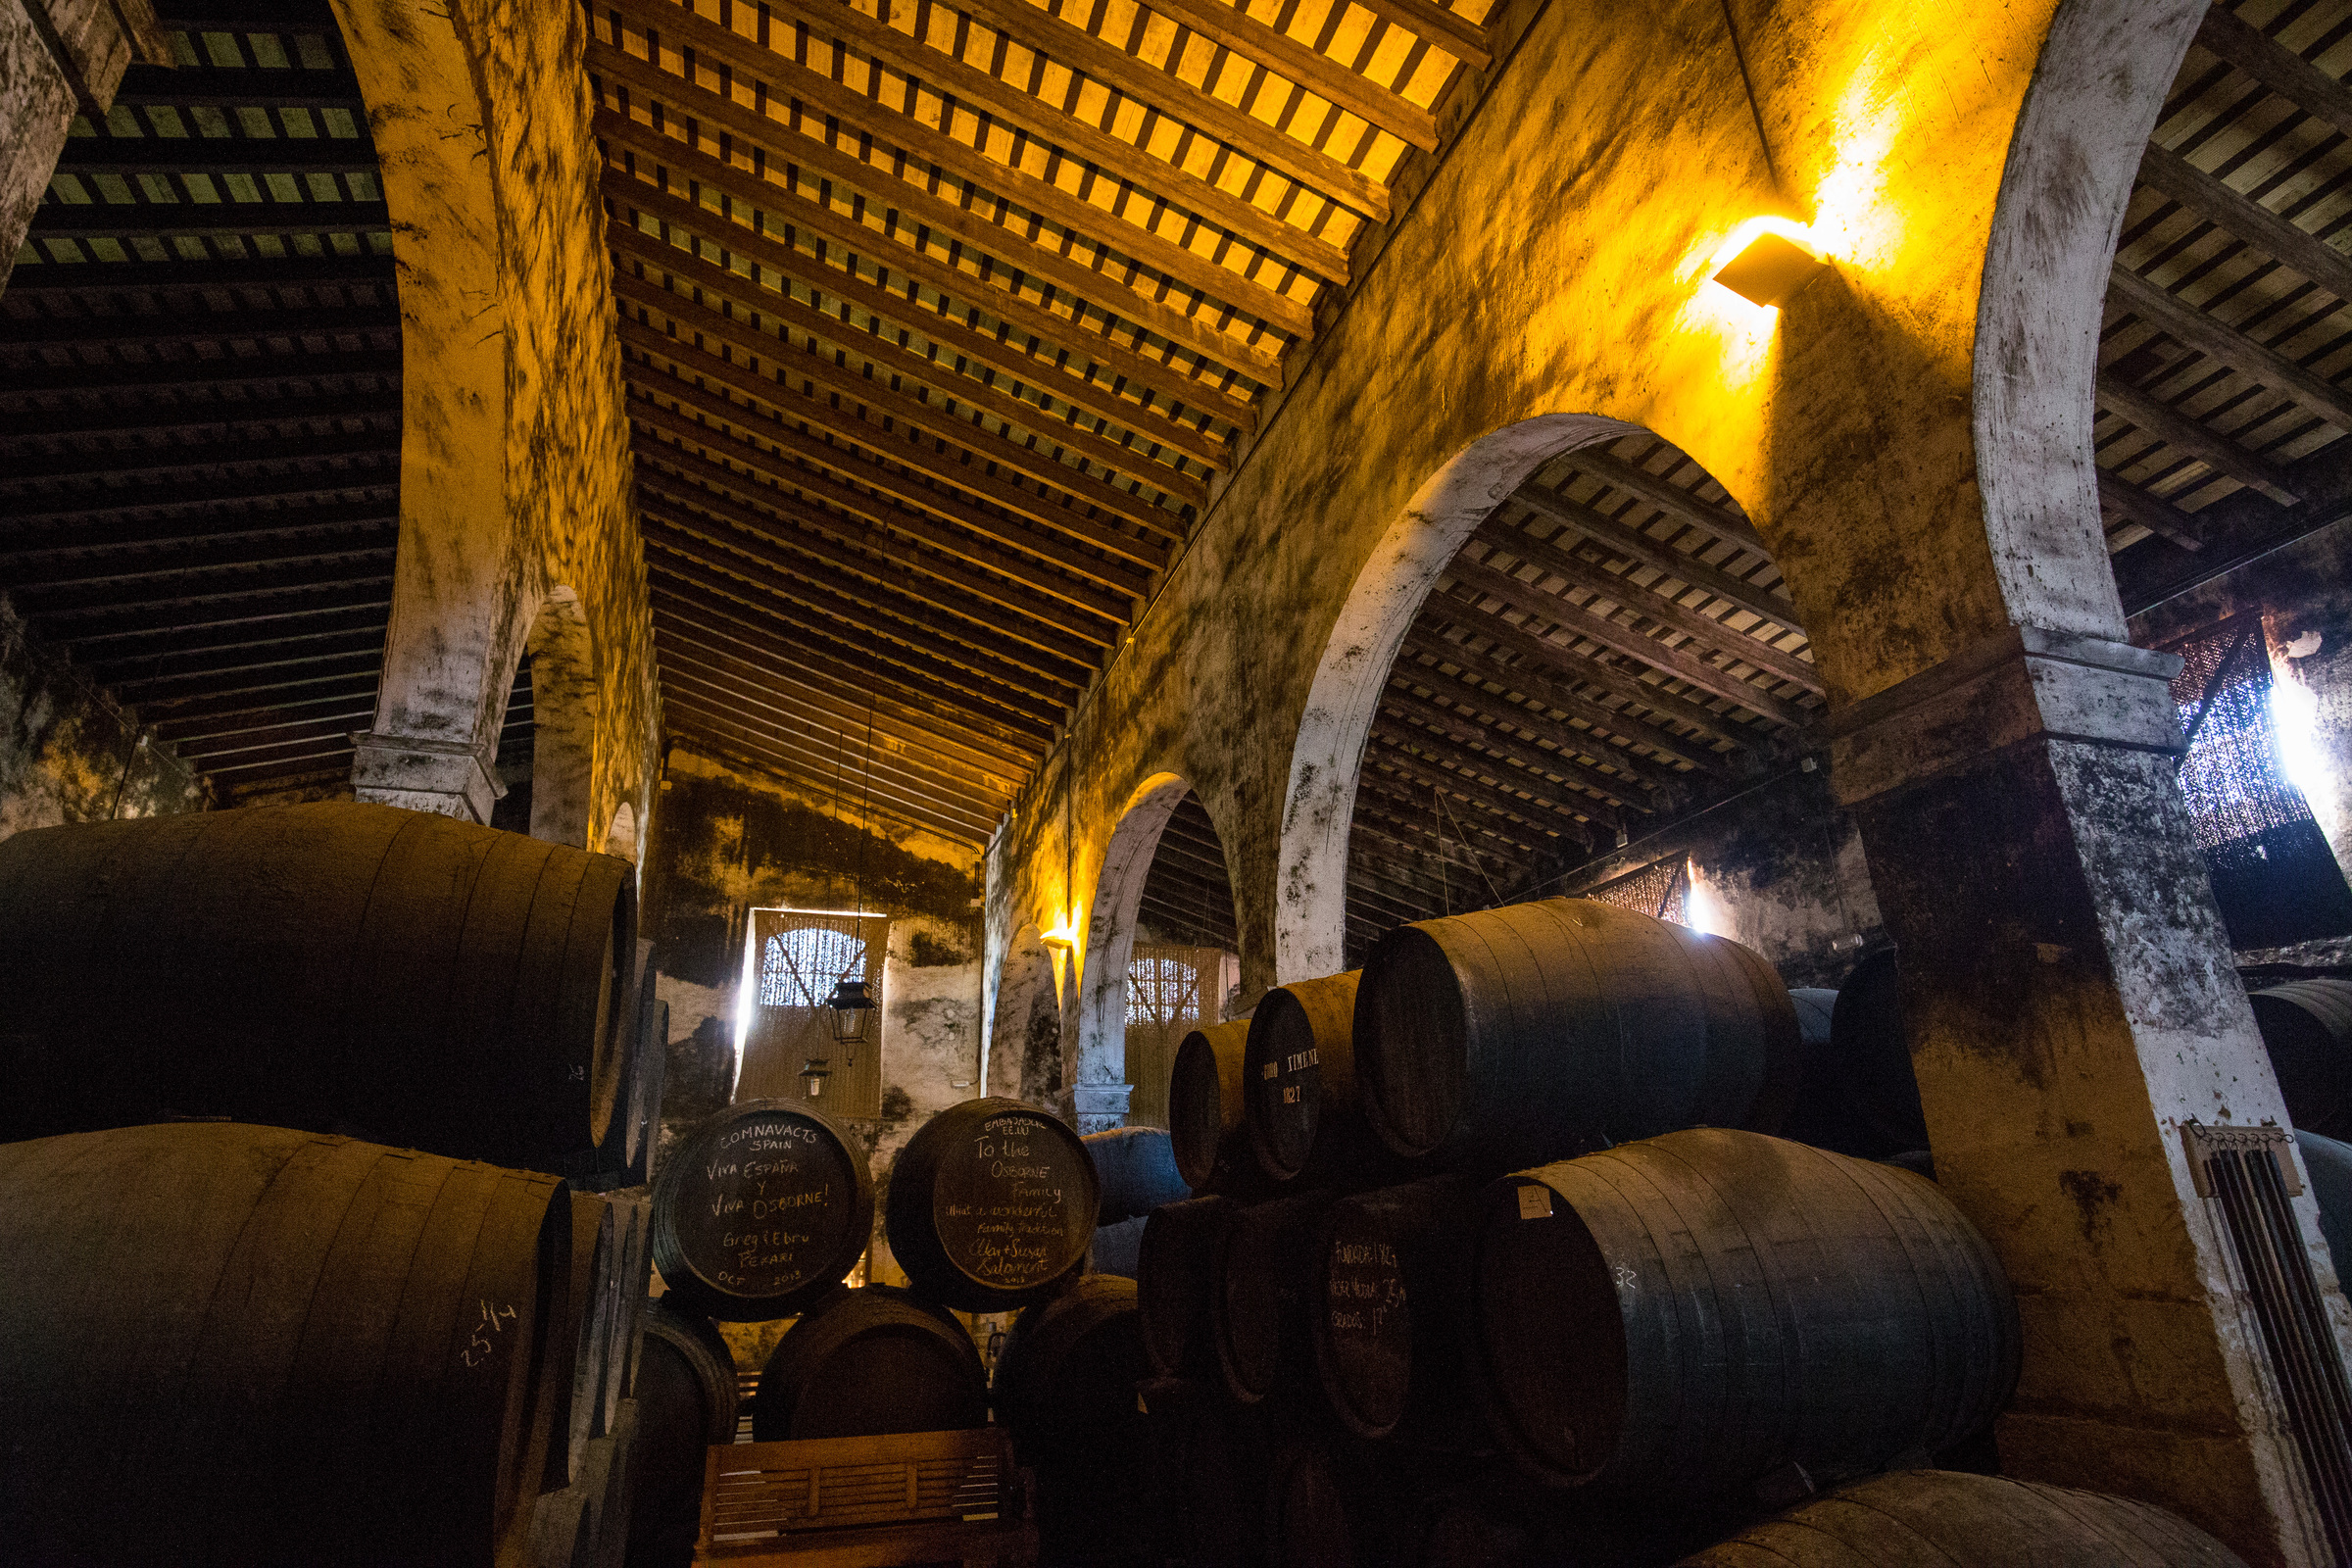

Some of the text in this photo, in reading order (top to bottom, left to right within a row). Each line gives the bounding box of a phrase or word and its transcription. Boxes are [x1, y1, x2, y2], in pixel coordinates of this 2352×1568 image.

[720, 1124, 818, 1149] COMNAVACTS
[749, 1140, 792, 1152] SPAIN
[973, 1136, 1030, 1158] To the
[743, 1159, 799, 1179] ESPAÑA
[991, 1160, 1051, 1179] OSBORNE
[723, 1231, 759, 1253] Greg
[717, 1271, 746, 1286] OCT
